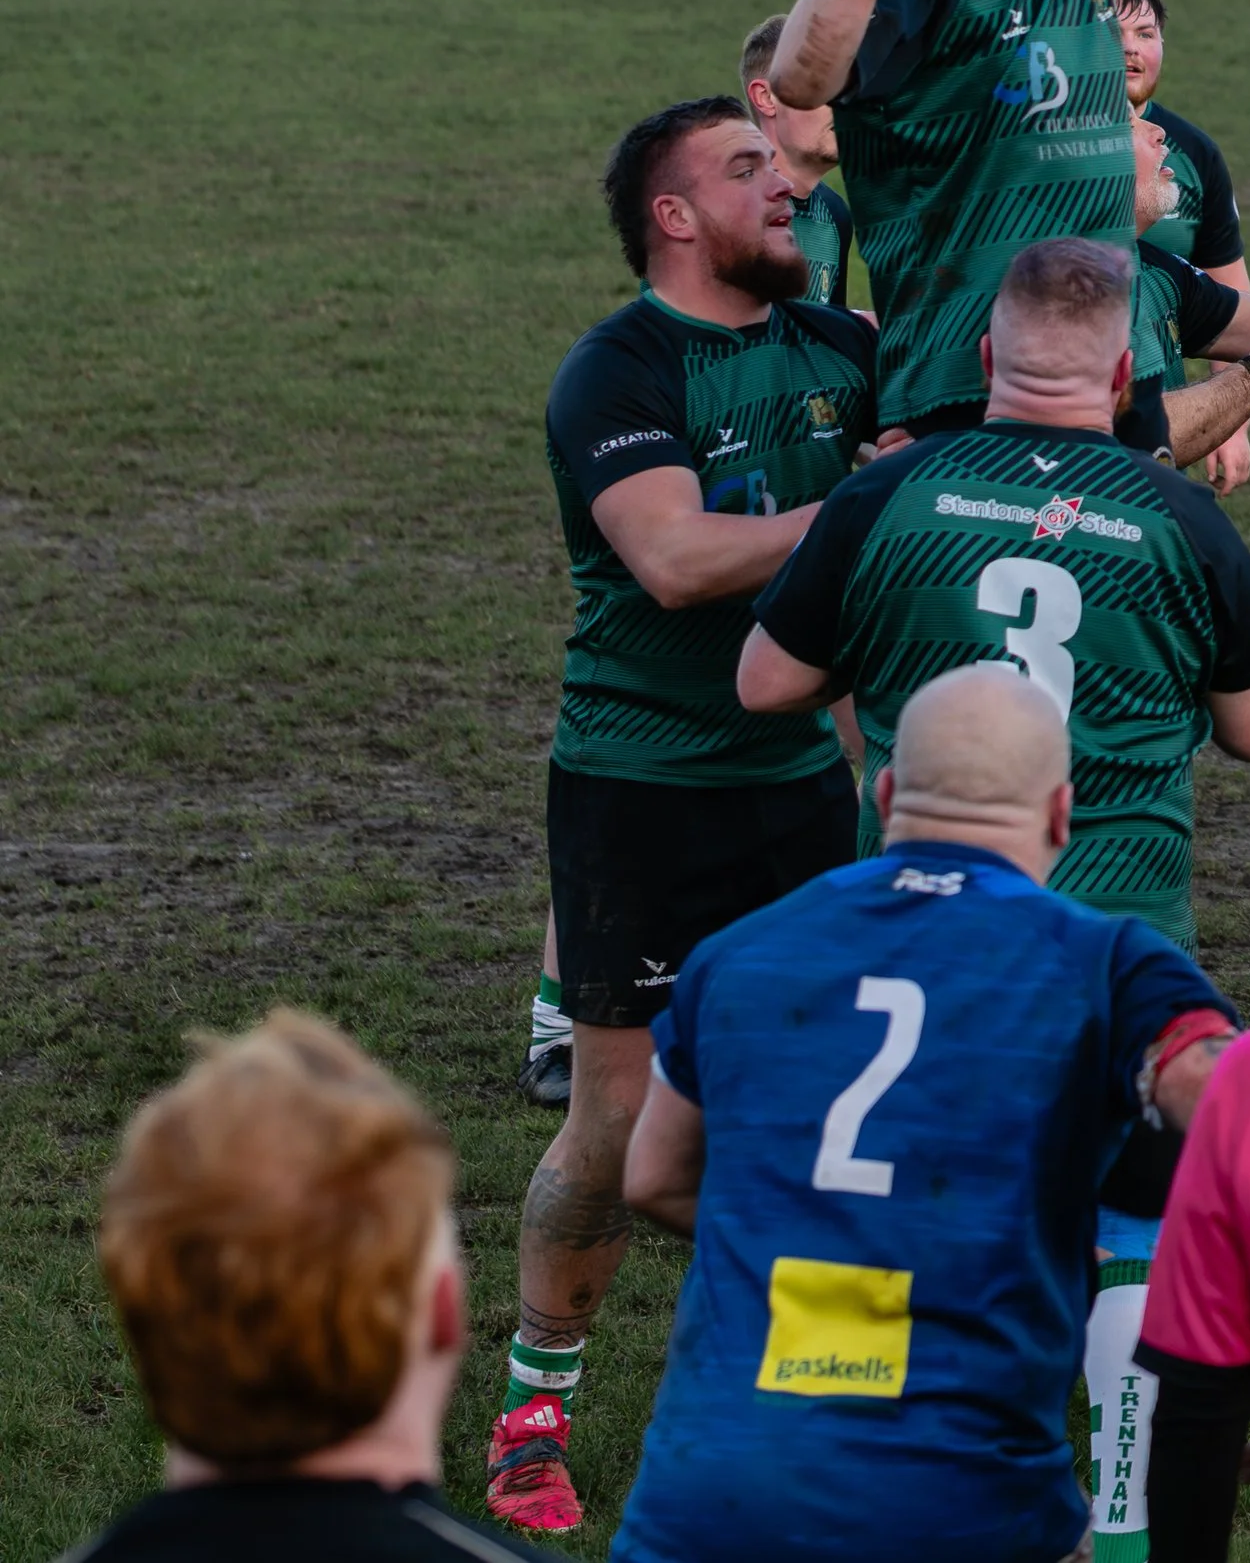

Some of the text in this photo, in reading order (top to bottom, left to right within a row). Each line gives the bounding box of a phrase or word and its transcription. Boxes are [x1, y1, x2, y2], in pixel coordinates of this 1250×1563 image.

[706, 440, 749, 459] vulcan
[936, 494, 1035, 524] Stantons
[1079, 511, 1142, 542] Stoke
[977, 557, 1082, 727] 3
[812, 975, 926, 1197] 2
[775, 1353, 895, 1383] gaskells
[1107, 1375, 1142, 1524] TRENTHAM
